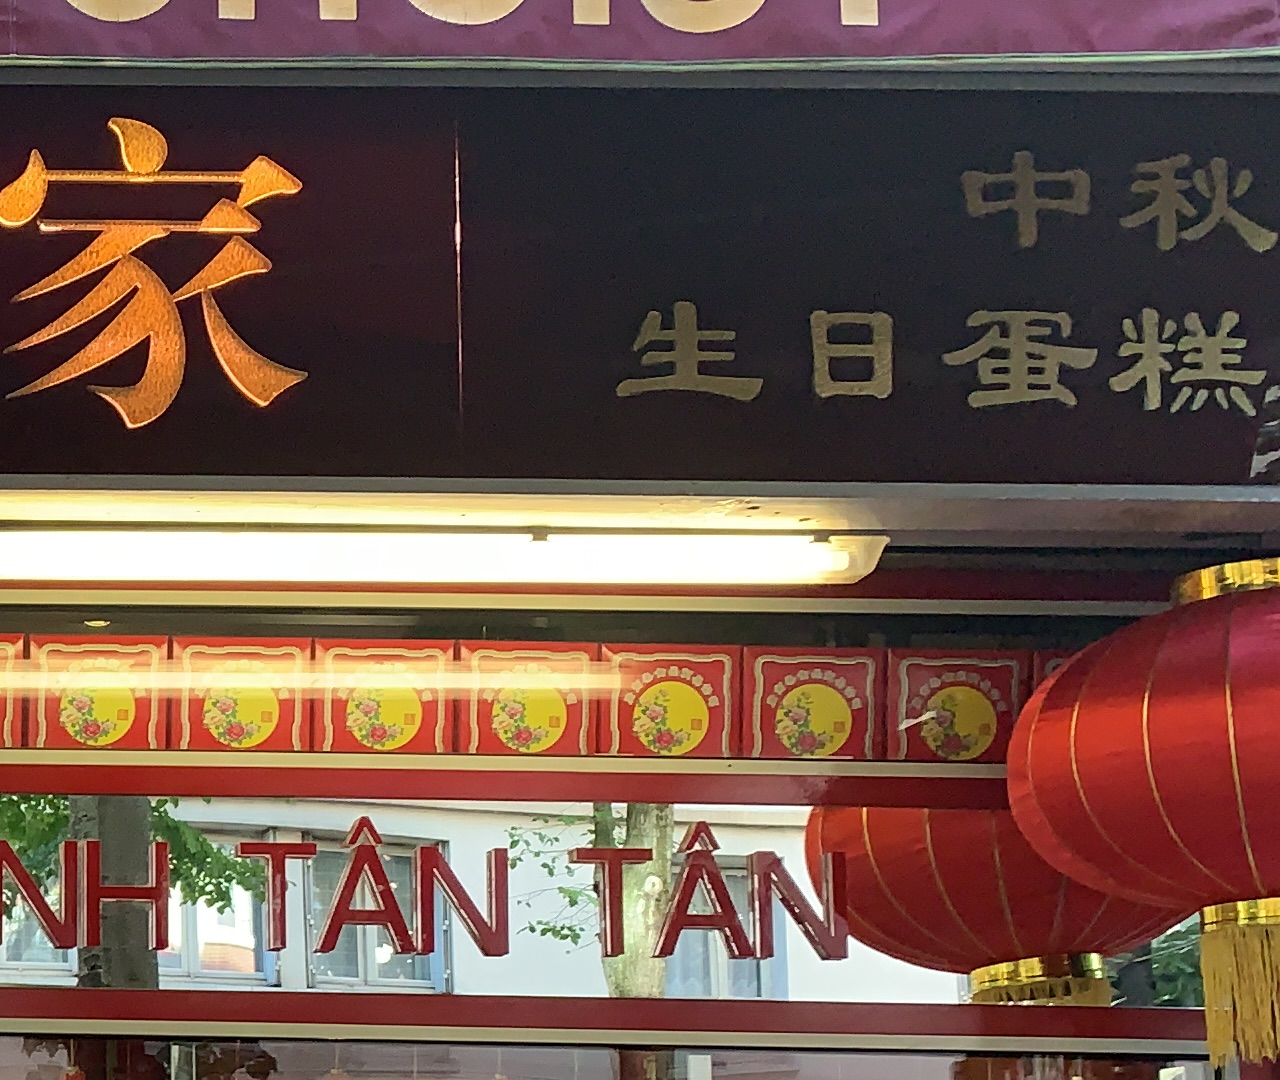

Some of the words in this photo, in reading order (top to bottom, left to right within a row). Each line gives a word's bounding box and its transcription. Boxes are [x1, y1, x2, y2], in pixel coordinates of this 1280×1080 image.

[960, 150, 1280, 253] 中秋
[616, 301, 1267, 417] 生日蛋糕
[233, 815, 510, 957] TÂN
[568, 820, 848, 962] TÂN
